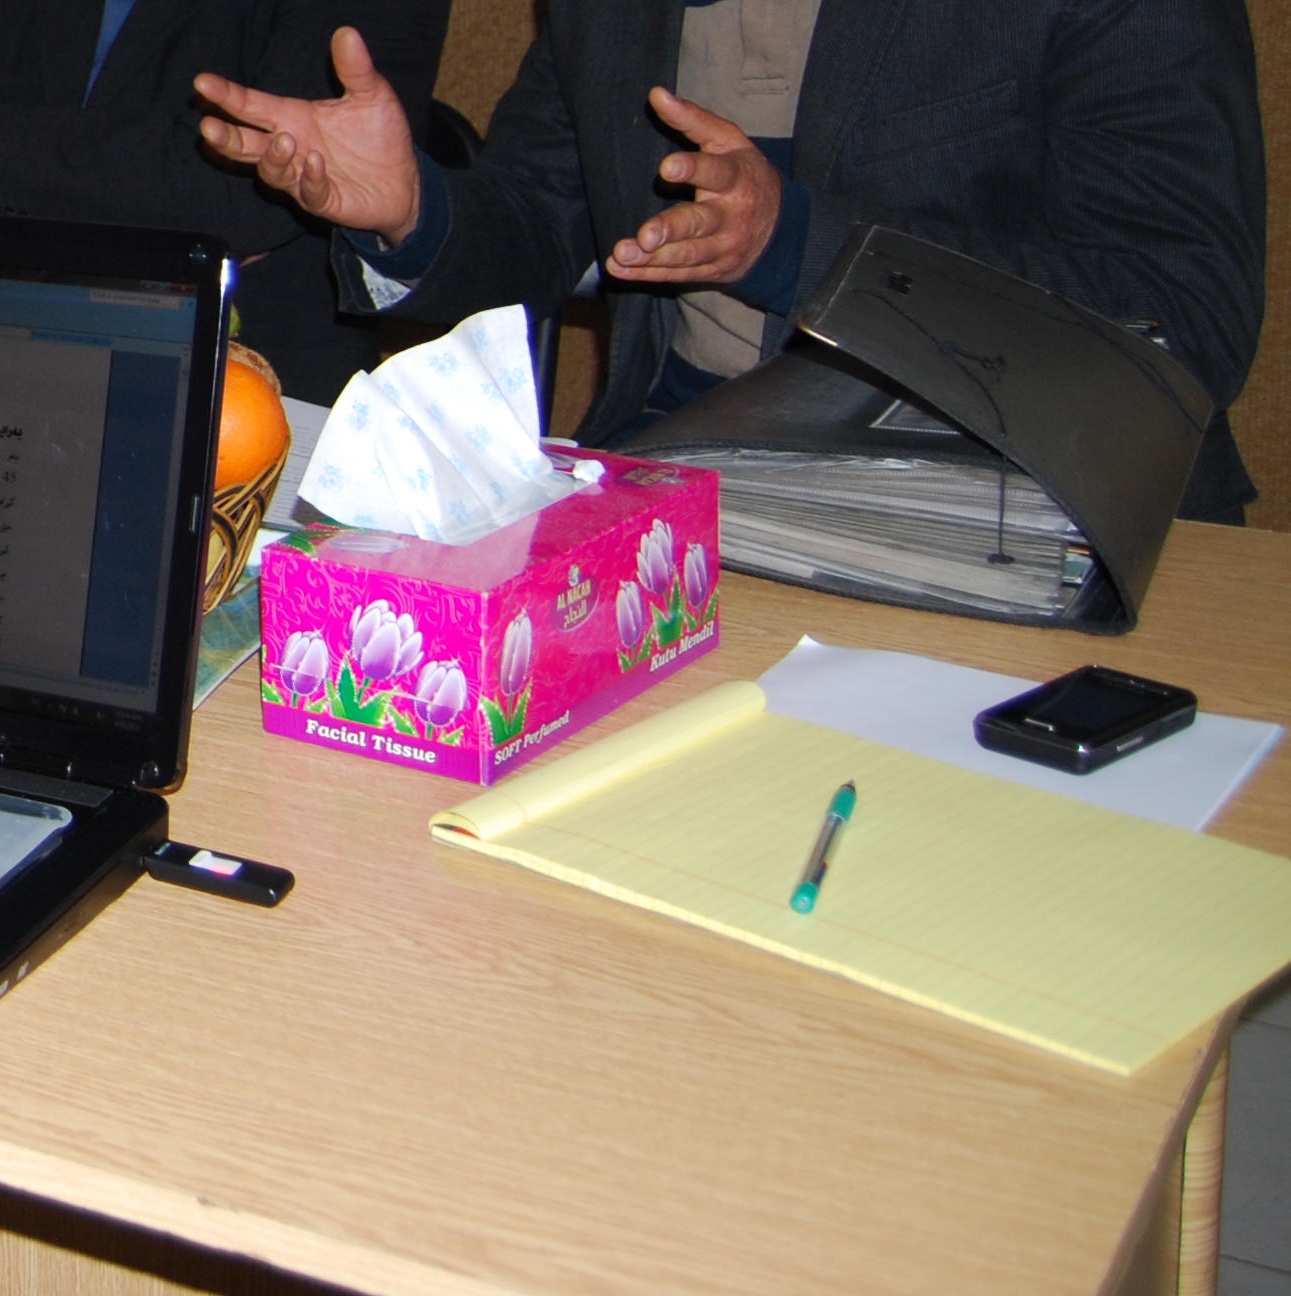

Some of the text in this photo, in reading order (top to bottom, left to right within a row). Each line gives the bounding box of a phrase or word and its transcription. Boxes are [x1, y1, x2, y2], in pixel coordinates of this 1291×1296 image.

[650, 620, 714, 673] Kutu Mendil
[305, 718, 437, 763] Facial Tissue
[494, 709, 570, 766] SOFT Perfumed
